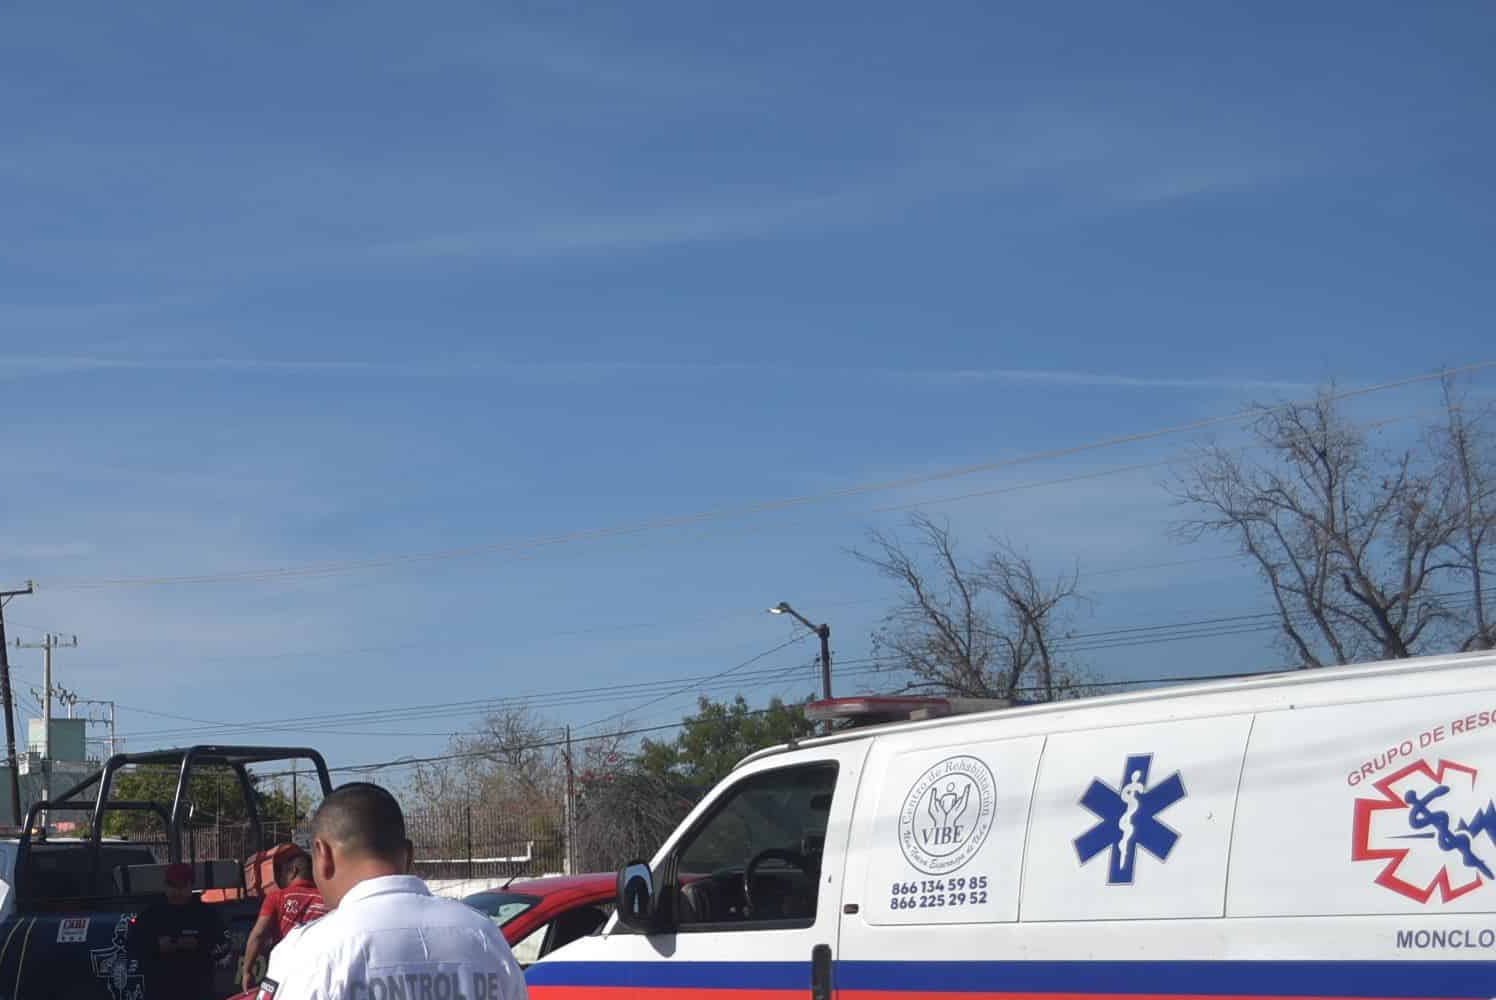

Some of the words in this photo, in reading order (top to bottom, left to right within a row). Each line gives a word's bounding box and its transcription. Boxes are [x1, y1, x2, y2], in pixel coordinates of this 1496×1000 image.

[1347, 740, 1414, 787] GRUPO
[1419, 726, 1445, 749] DE
[922, 825, 965, 846] VIBE
[891, 882, 918, 896] 866
[920, 880, 945, 894] 134
[947, 878, 966, 892] 59
[969, 876, 988, 890] 85
[890, 897, 917, 911] 866
[919, 894, 945, 908] 225
[948, 893, 966, 906] 29
[969, 891, 988, 905] 52
